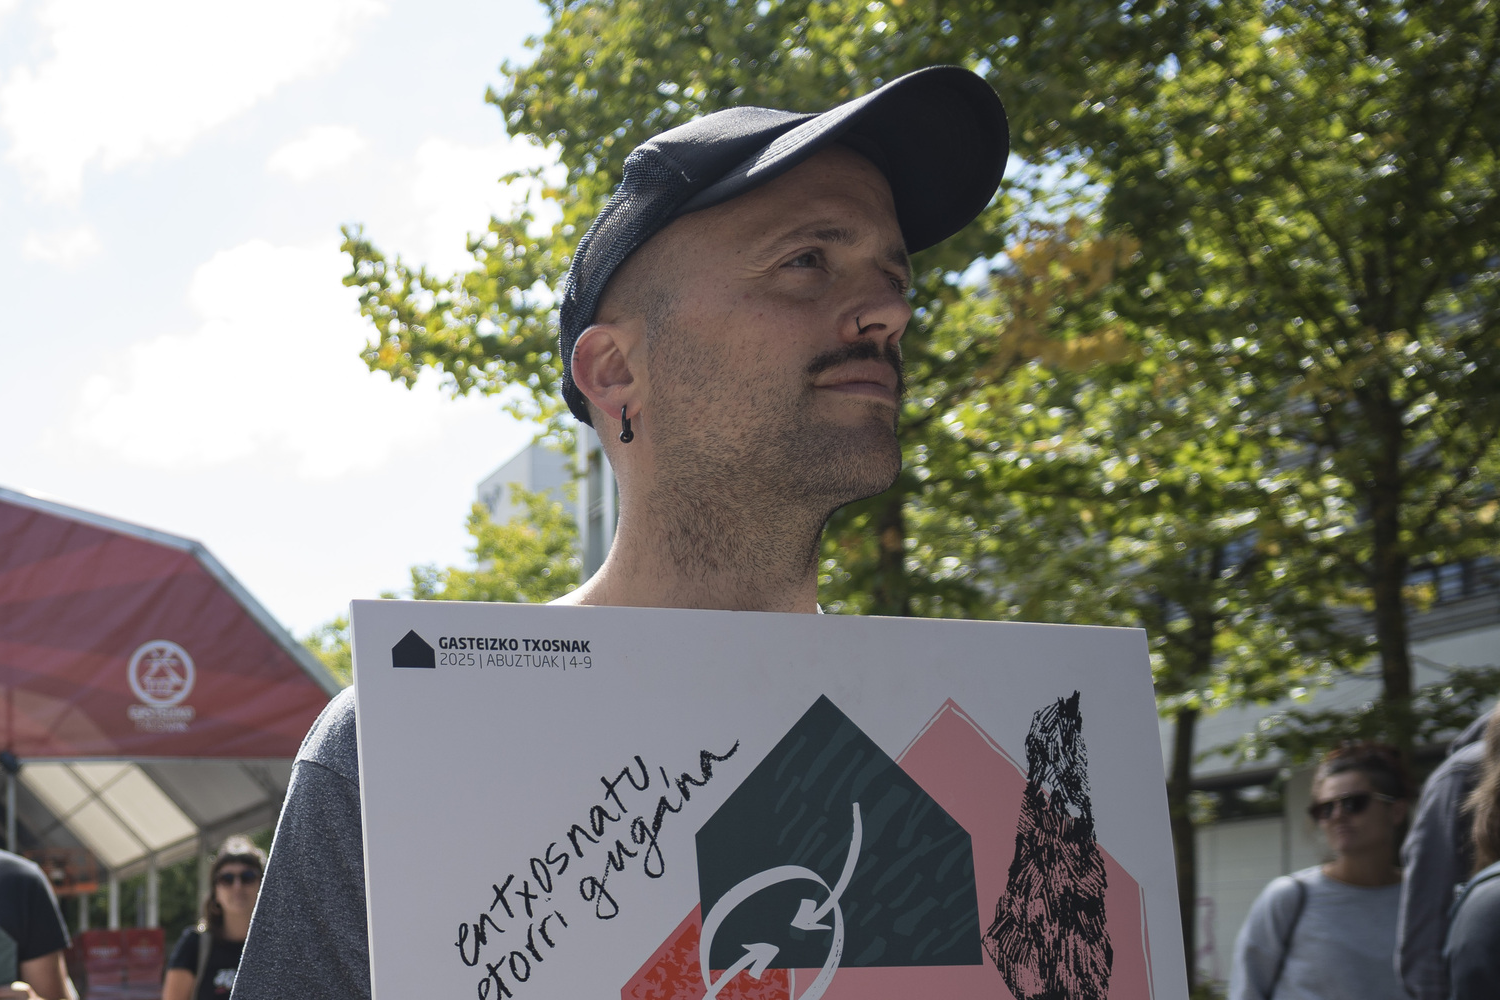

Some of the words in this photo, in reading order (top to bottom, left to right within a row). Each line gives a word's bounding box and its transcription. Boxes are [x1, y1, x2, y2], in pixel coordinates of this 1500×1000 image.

[439, 637, 519, 651] GASTEIZKO
[522, 639, 591, 653] TXOSNAK
[440, 652, 475, 666] 2025
[486, 653, 559, 668] ABUZTUAK
[569, 655, 592, 669] 4-9
